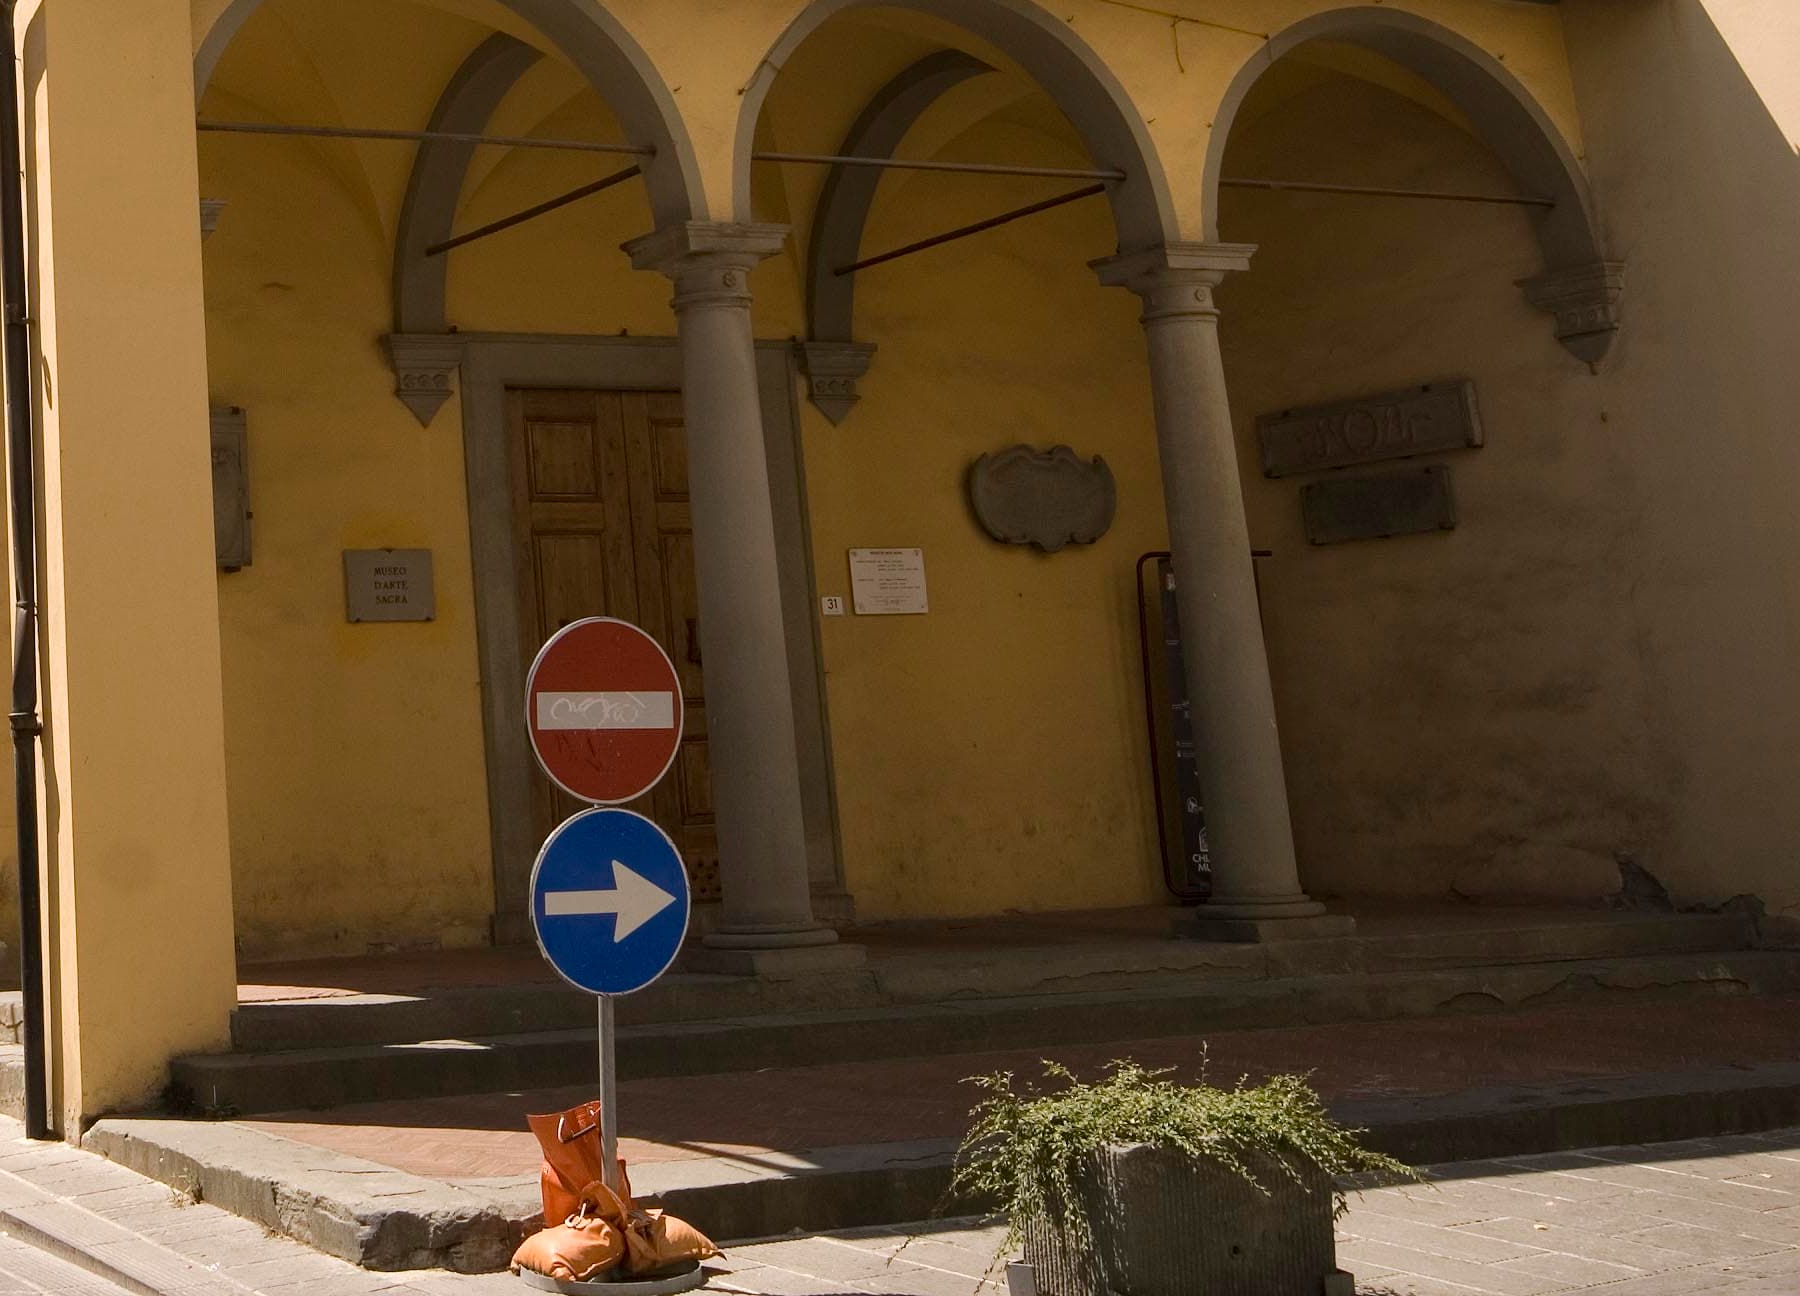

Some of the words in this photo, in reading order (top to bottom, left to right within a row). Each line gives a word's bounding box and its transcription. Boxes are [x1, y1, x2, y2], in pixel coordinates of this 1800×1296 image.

[374, 567, 407, 576] MUSEO
[375, 595, 408, 605] SACRA
[827, 598, 838, 610] 31
